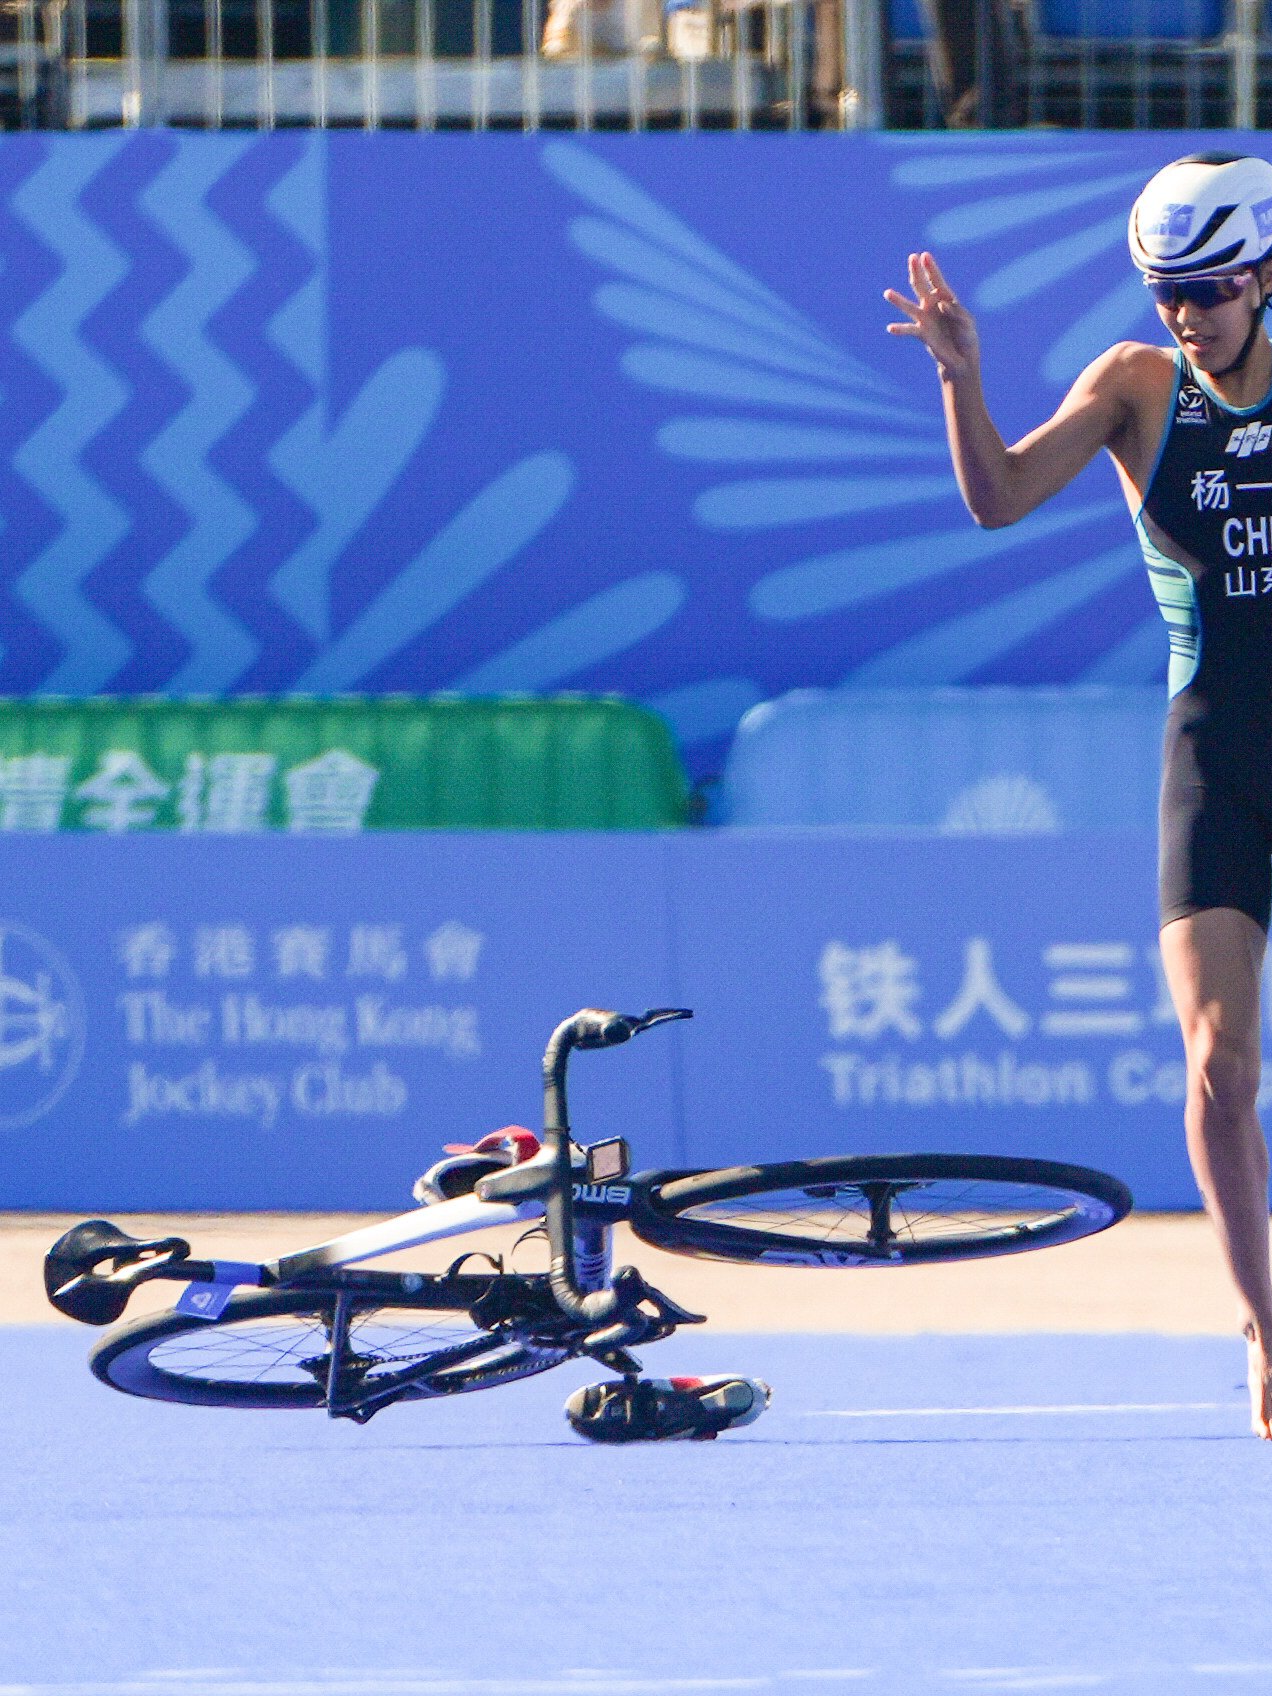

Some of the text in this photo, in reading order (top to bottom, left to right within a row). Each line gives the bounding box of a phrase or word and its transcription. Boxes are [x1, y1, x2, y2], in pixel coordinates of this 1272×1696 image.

[120, 992, 481, 1057] The Hong Kong
[122, 1058, 407, 1127] Jockey Club
[819, 1053, 1091, 1104] Triathlon
